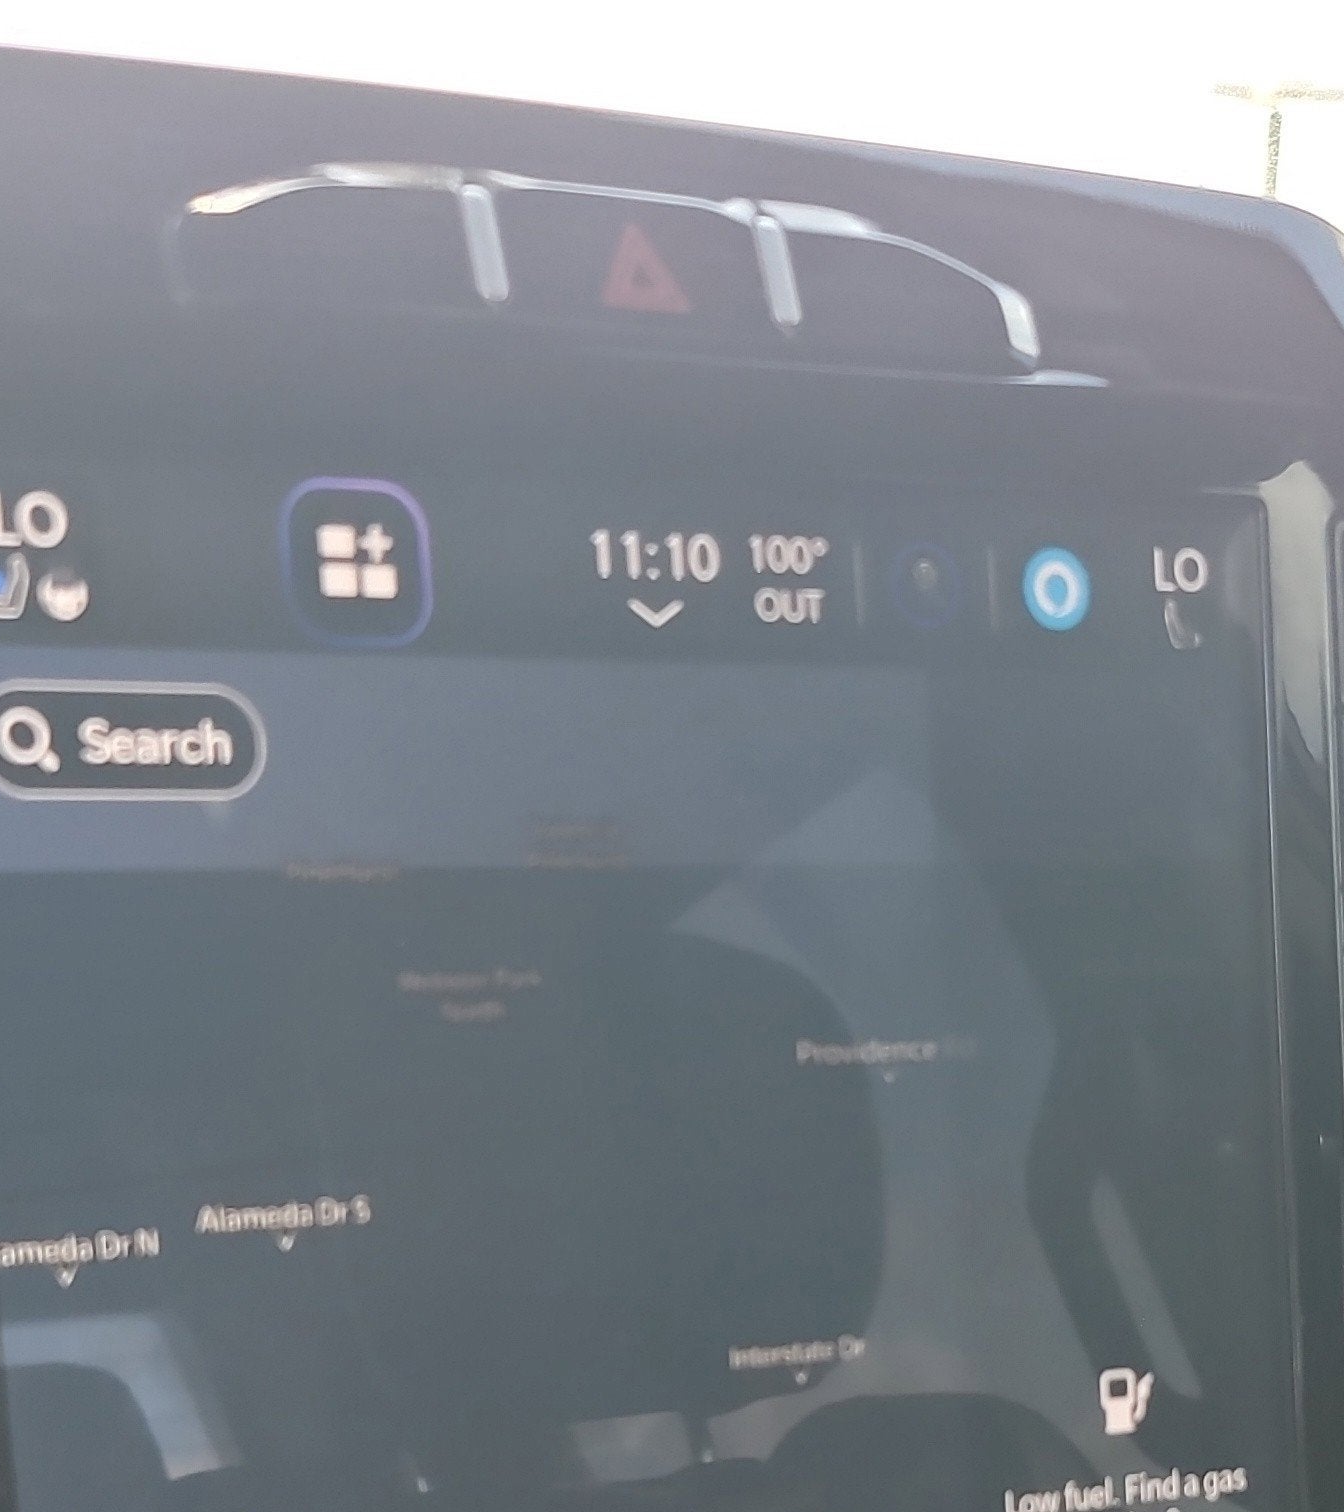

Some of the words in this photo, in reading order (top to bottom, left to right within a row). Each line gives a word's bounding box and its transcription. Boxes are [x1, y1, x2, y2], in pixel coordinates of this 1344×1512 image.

[590, 529, 720, 583] 11:10
[1153, 547, 1208, 593] LO
[755, 588, 825, 623] OUT
[78, 716, 232, 766] Search
[195, 1201, 313, 1234] Alameda
[314, 1196, 349, 1227] Dr
[350, 1193, 371, 1225] S
[95, 1229, 132, 1261] Dr
[133, 1226, 160, 1257] N
[1125, 1467, 1180, 1505] Find
[1184, 1473, 1200, 1498] a
[1203, 1467, 1247, 1502] gas
